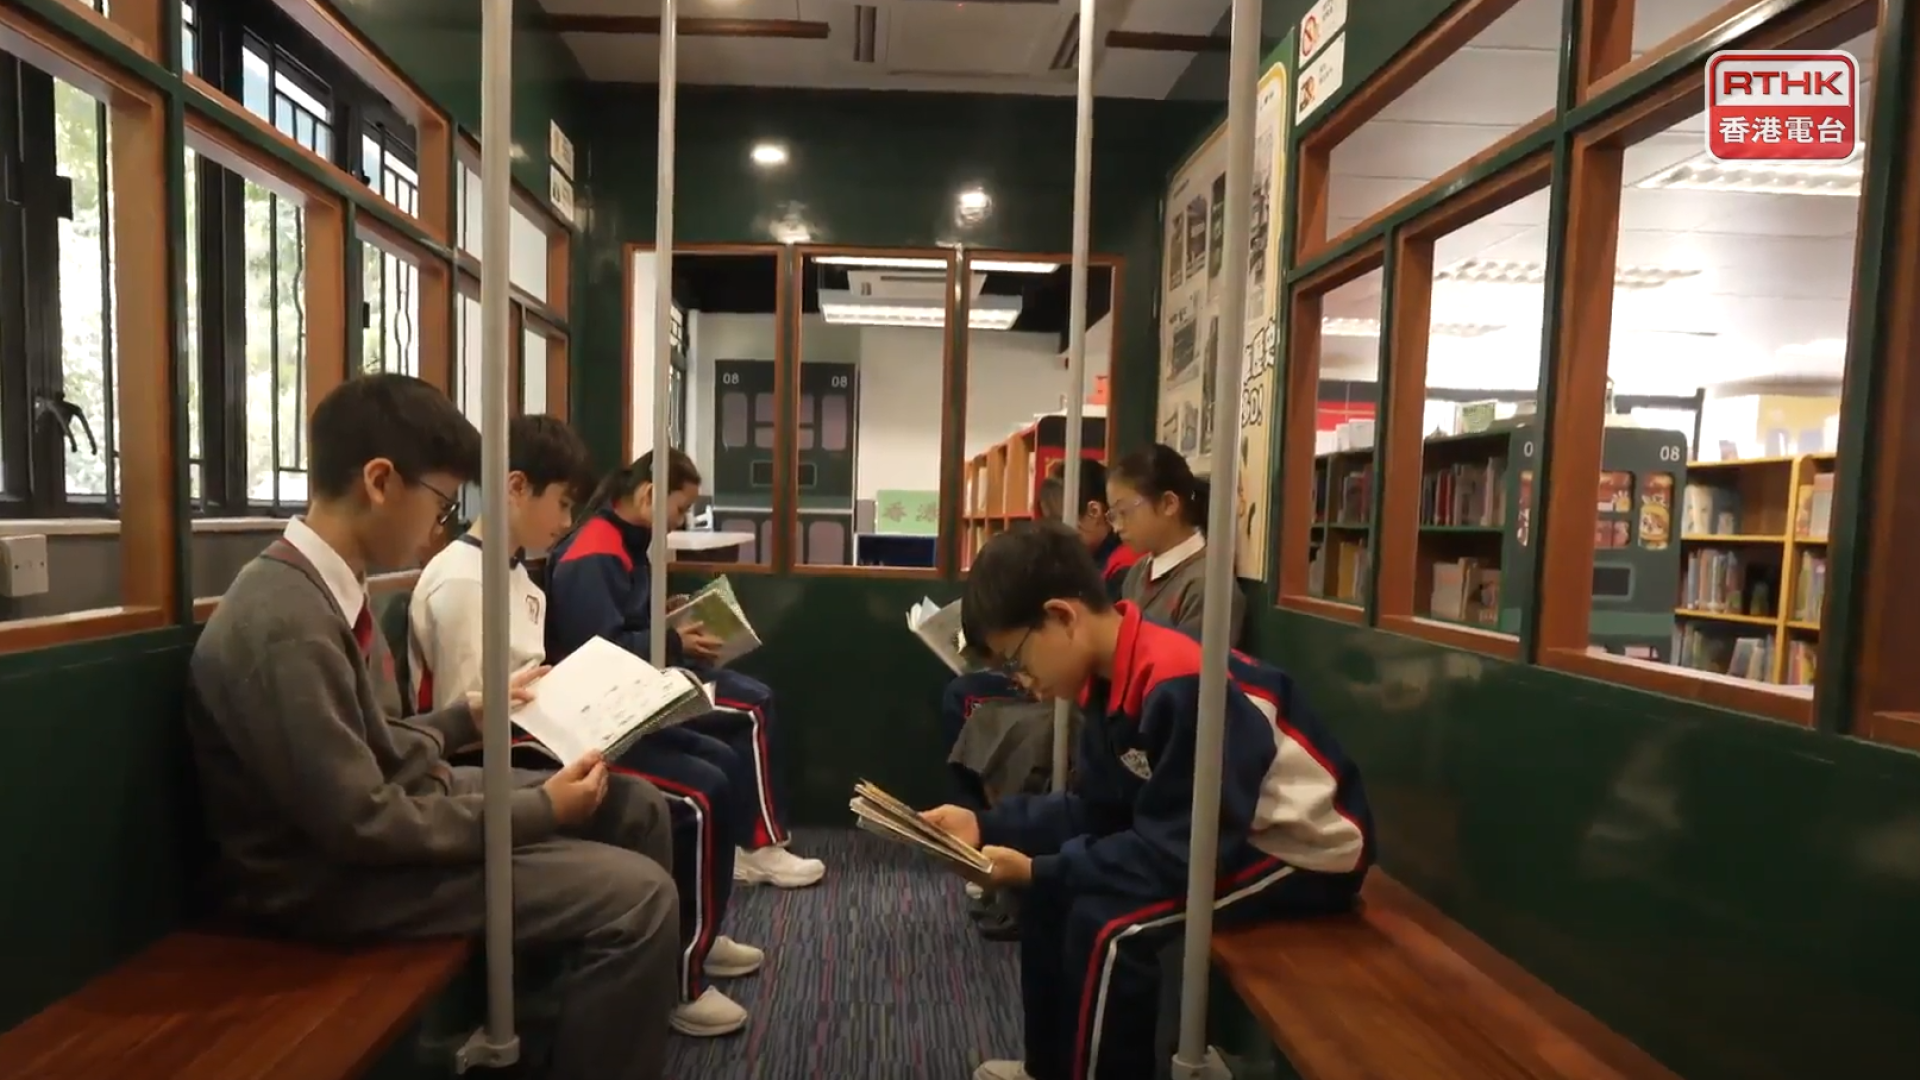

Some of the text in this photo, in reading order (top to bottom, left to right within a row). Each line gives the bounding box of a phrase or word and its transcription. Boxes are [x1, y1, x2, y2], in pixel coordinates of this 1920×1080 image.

[723, 372, 740, 385] 08
[831, 375, 848, 388] 08
[1524, 441, 1534, 457] 0
[1660, 445, 1680, 461] 08
